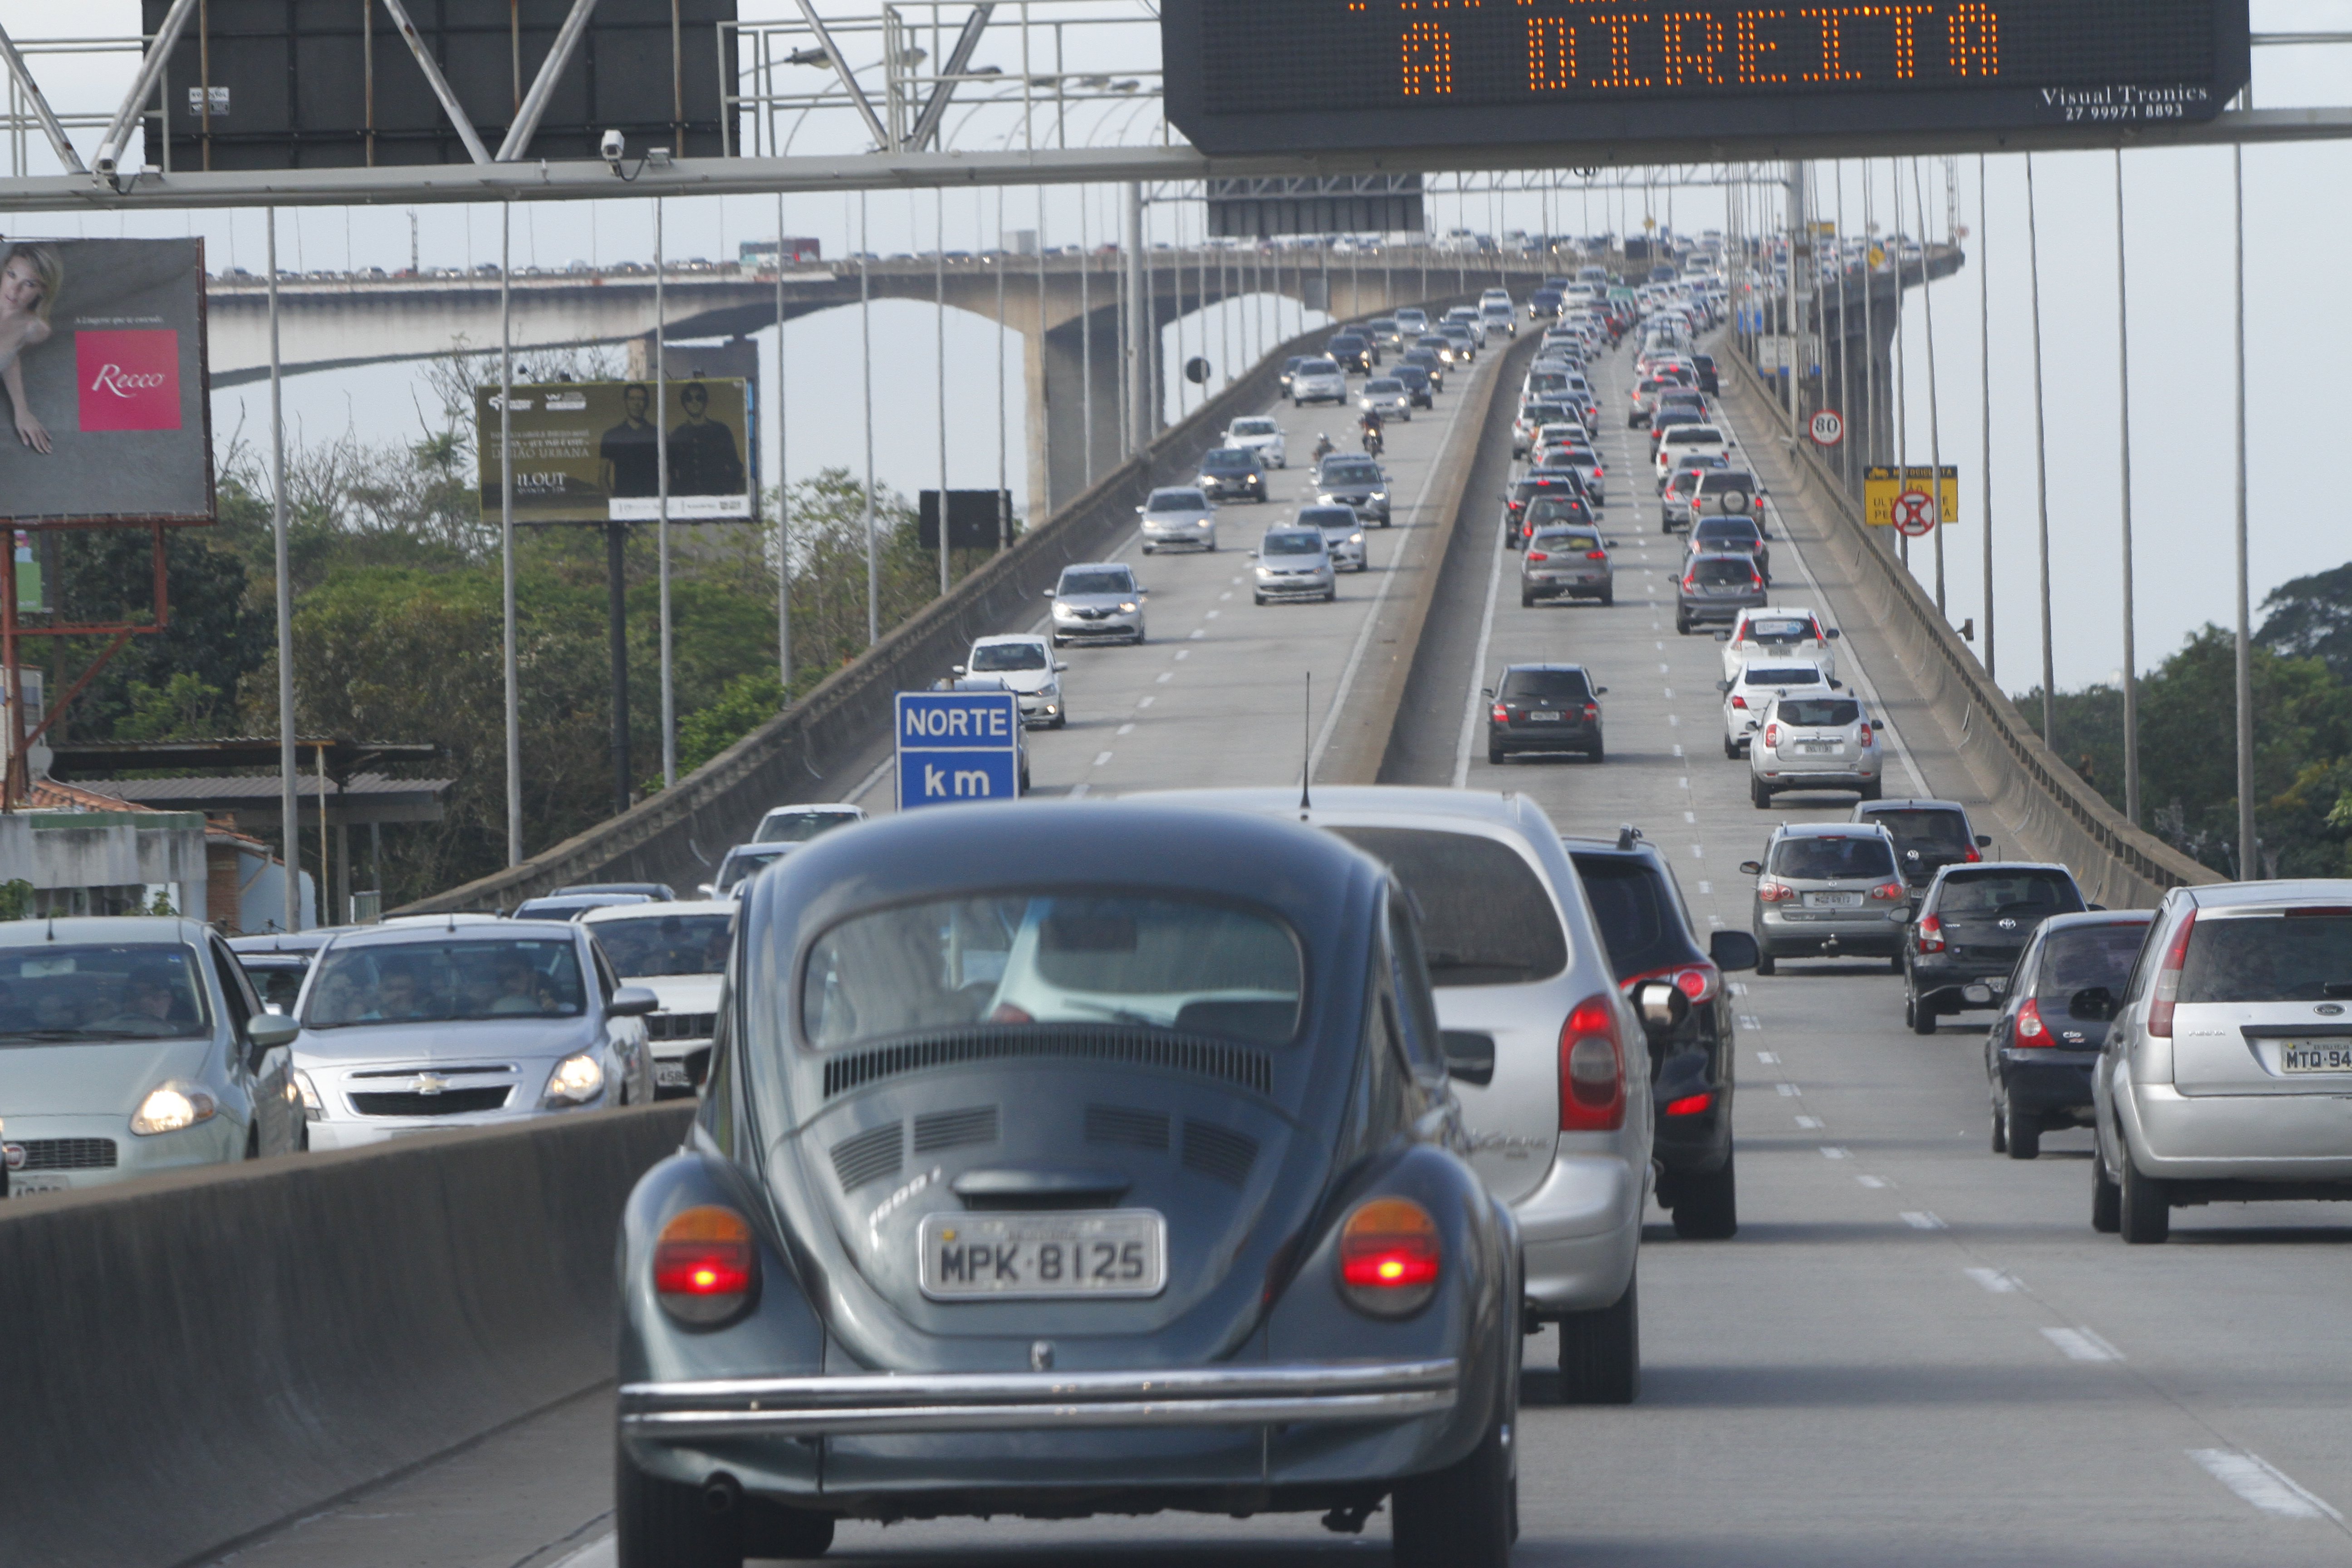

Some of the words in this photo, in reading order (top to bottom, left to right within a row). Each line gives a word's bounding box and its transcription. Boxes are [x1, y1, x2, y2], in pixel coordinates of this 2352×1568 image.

[1402, 22, 1452, 94] A
[1528, 2, 1998, 91] DIREITA
[2042, 85, 2112, 106] Visual
[2118, 83, 2208, 104] Tronics
[2066, 106, 2083, 122] 27
[2091, 103, 2136, 120] 99971
[2145, 103, 2183, 118] 8893
[92, 363, 166, 398] Recco
[1815, 416, 1838, 433] 80
[906, 708, 1007, 737] NORTE
[924, 763, 991, 797] km
